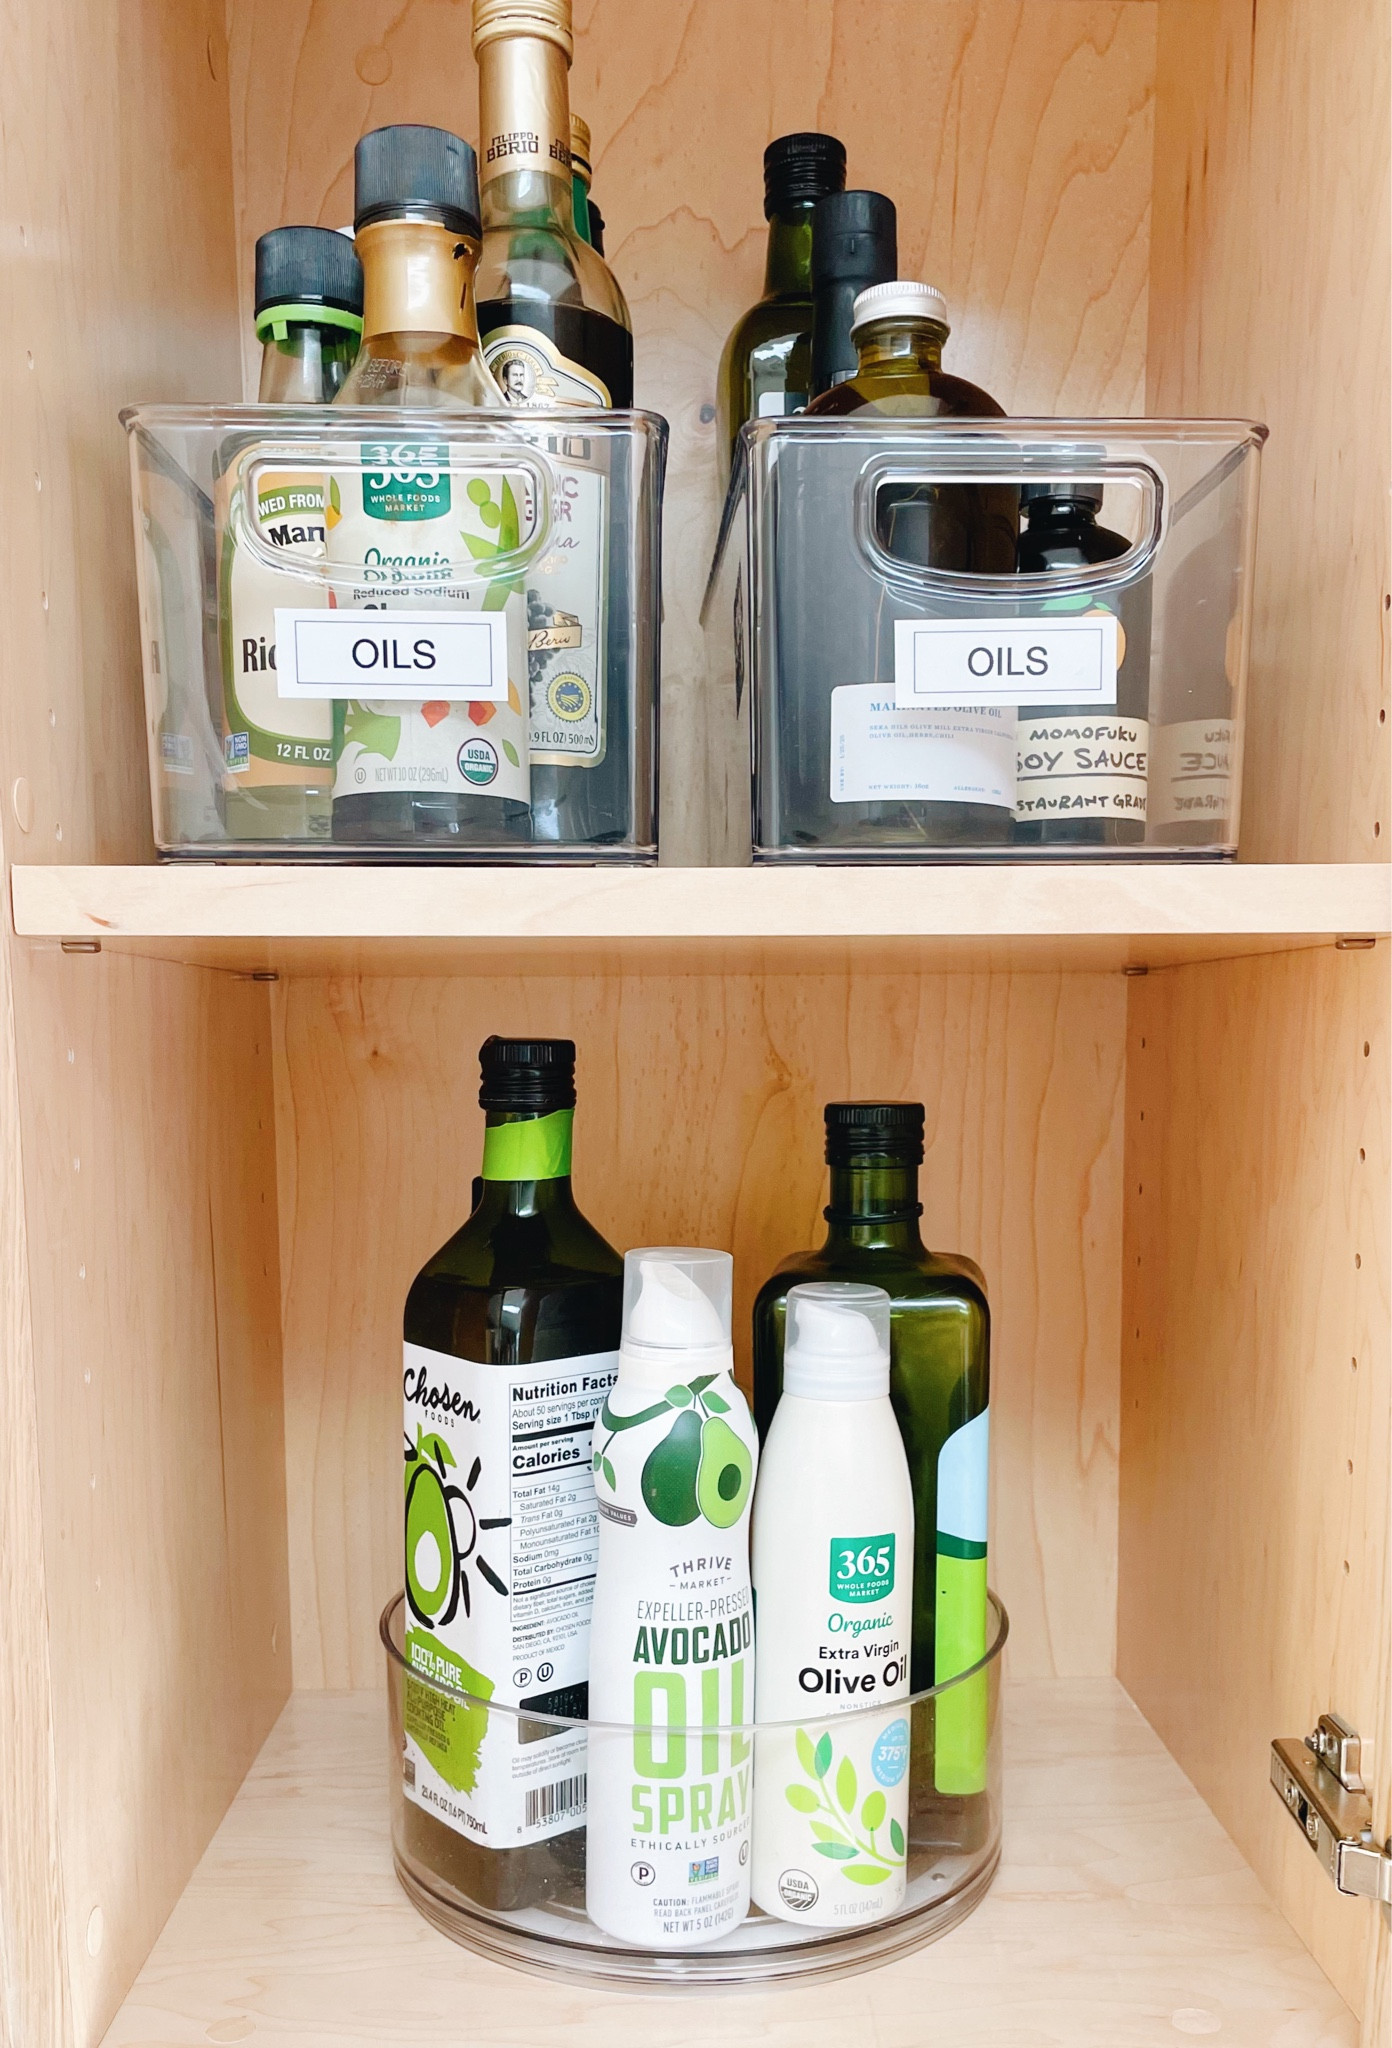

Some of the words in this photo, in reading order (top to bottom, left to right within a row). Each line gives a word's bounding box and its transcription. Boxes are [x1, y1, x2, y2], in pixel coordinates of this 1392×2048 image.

[487, 141, 538, 164] BERIO
[371, 494, 403, 503] WHOLE
[407, 493, 440, 503] FOODS
[385, 504, 425, 512] MARKET
[353, 588, 409, 600] Reduced
[414, 586, 470, 600] Sodium
[352, 638, 436, 669] OILS
[968, 646, 1048, 677] OILS
[988, 708, 1002, 718] OIL
[528, 732, 539, 742] .9
[541, 732, 551, 742] FL
[276, 743, 291, 757] 12
[294, 746, 309, 759] FL
[313, 748, 332, 761] OZ
[467, 749, 491, 761] USDA
[1074, 748, 1146, 771] SAUCE
[403, 1366, 481, 1422] Chosen
[512, 1381, 577, 1401] Nutrition
[512, 1406, 535, 1418] About
[537, 1405, 546, 1416] 50
[547, 1401, 576, 1413] servings
[577, 1399, 588, 1408] per
[512, 1419, 544, 1430] Serving
[546, 1415, 562, 1425] size
[571, 1411, 590, 1421] Tbsp
[512, 1443, 538, 1451] Amount
[551, 1437, 574, 1446] serving
[512, 1448, 580, 1469] Calories
[513, 1489, 532, 1498] Total
[534, 1487, 546, 1496] Fat
[548, 1484, 560, 1493] 14g
[520, 1497, 554, 1511] Saturated
[555, 1495, 566, 1503] Fat
[568, 1493, 577, 1501] 2g
[520, 1519, 575, 1537] Polyunsaturated
[576, 1516, 587, 1525] Fat
[588, 1514, 597, 1523] 2g
[521, 1514, 540, 1524] Trans
[541, 1511, 553, 1520] Fat
[554, 1509, 563, 1517] 0g
[520, 1531, 579, 1549] Monounsaturated
[580, 1527, 591, 1536] Fat
[513, 1552, 542, 1563] Sodium
[544, 1549, 559, 1558] 0mg
[513, 1567, 532, 1576] Total
[534, 1555, 582, 1572] Carbohydrate
[583, 1553, 592, 1561] 0g
[837, 1545, 890, 1579] 365
[669, 1556, 732, 1578] THRIVE
[513, 1579, 541, 1589] Protein
[542, 1576, 551, 1584] 0g
[680, 1577, 725, 1590] MARKET
[867, 1579, 889, 1588] FOODS
[849, 1589, 879, 1597] MARKET
[828, 1612, 893, 1638] Organic
[632, 1610, 751, 1665] AVOCADO
[819, 1646, 859, 1660] Extra
[864, 1640, 899, 1658] Virgin
[411, 1641, 435, 1670] 100%
[436, 1655, 462, 1686] PURE
[798, 1667, 876, 1694] Olive
[883, 1654, 907, 1687] Oil
[633, 1658, 751, 1779] OIL
[631, 1764, 750, 1835] SPRAY
[536, 1811, 565, 1828] 53807
[631, 1838, 707, 1851] ETHICALLY
[787, 1878, 809, 1890] USDA
[663, 1921, 680, 1934] NET
[683, 1920, 695, 1932] WT
[704, 1916, 713, 1928] OZ
